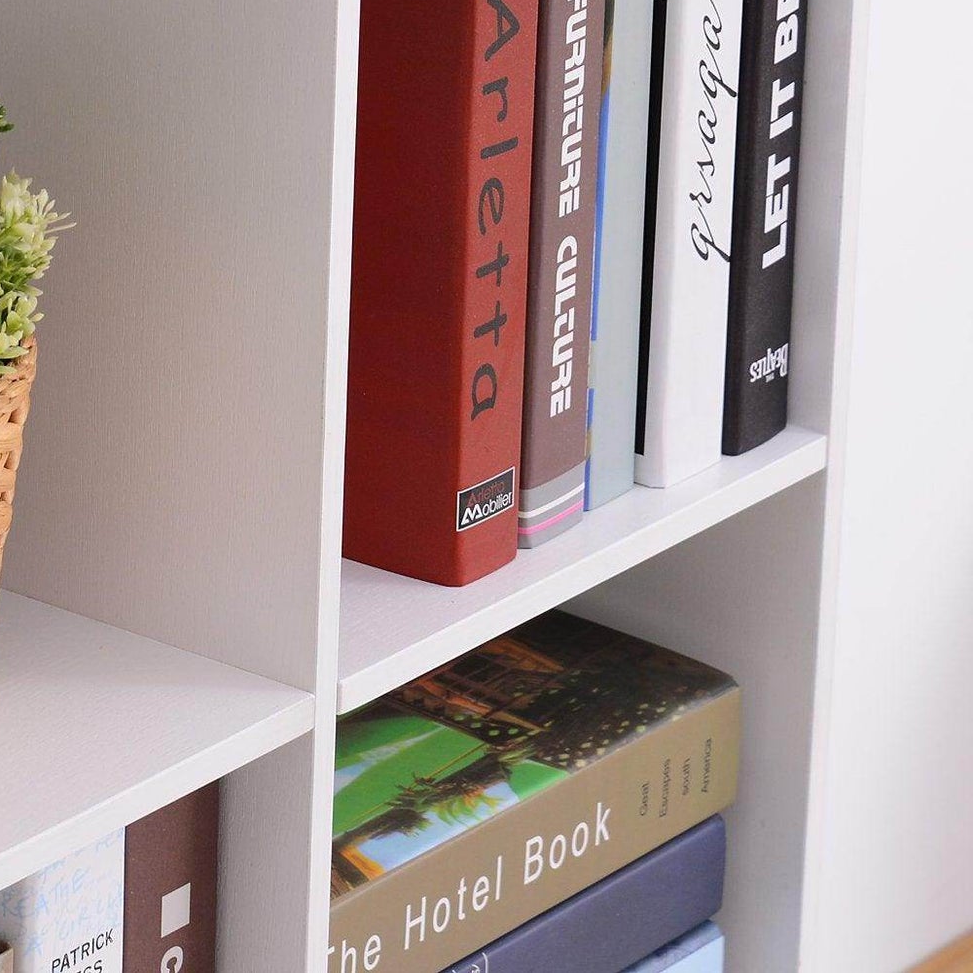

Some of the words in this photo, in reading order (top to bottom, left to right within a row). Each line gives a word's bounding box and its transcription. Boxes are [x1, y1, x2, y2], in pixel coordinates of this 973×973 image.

[770, 78, 795, 140] IT
[762, 153, 791, 270] LET
[550, 235, 578, 417] CULTURE
[460, 492, 513, 526] Mobilier
[659, 759, 671, 818] Escapes
[681, 757, 691, 797] south
[701, 738, 711, 793] America
[327, 934, 381, 973] he
[404, 855, 502, 950] Hotel
[524, 802, 611, 885] Book
[51, 929, 114, 973] PATRICK
